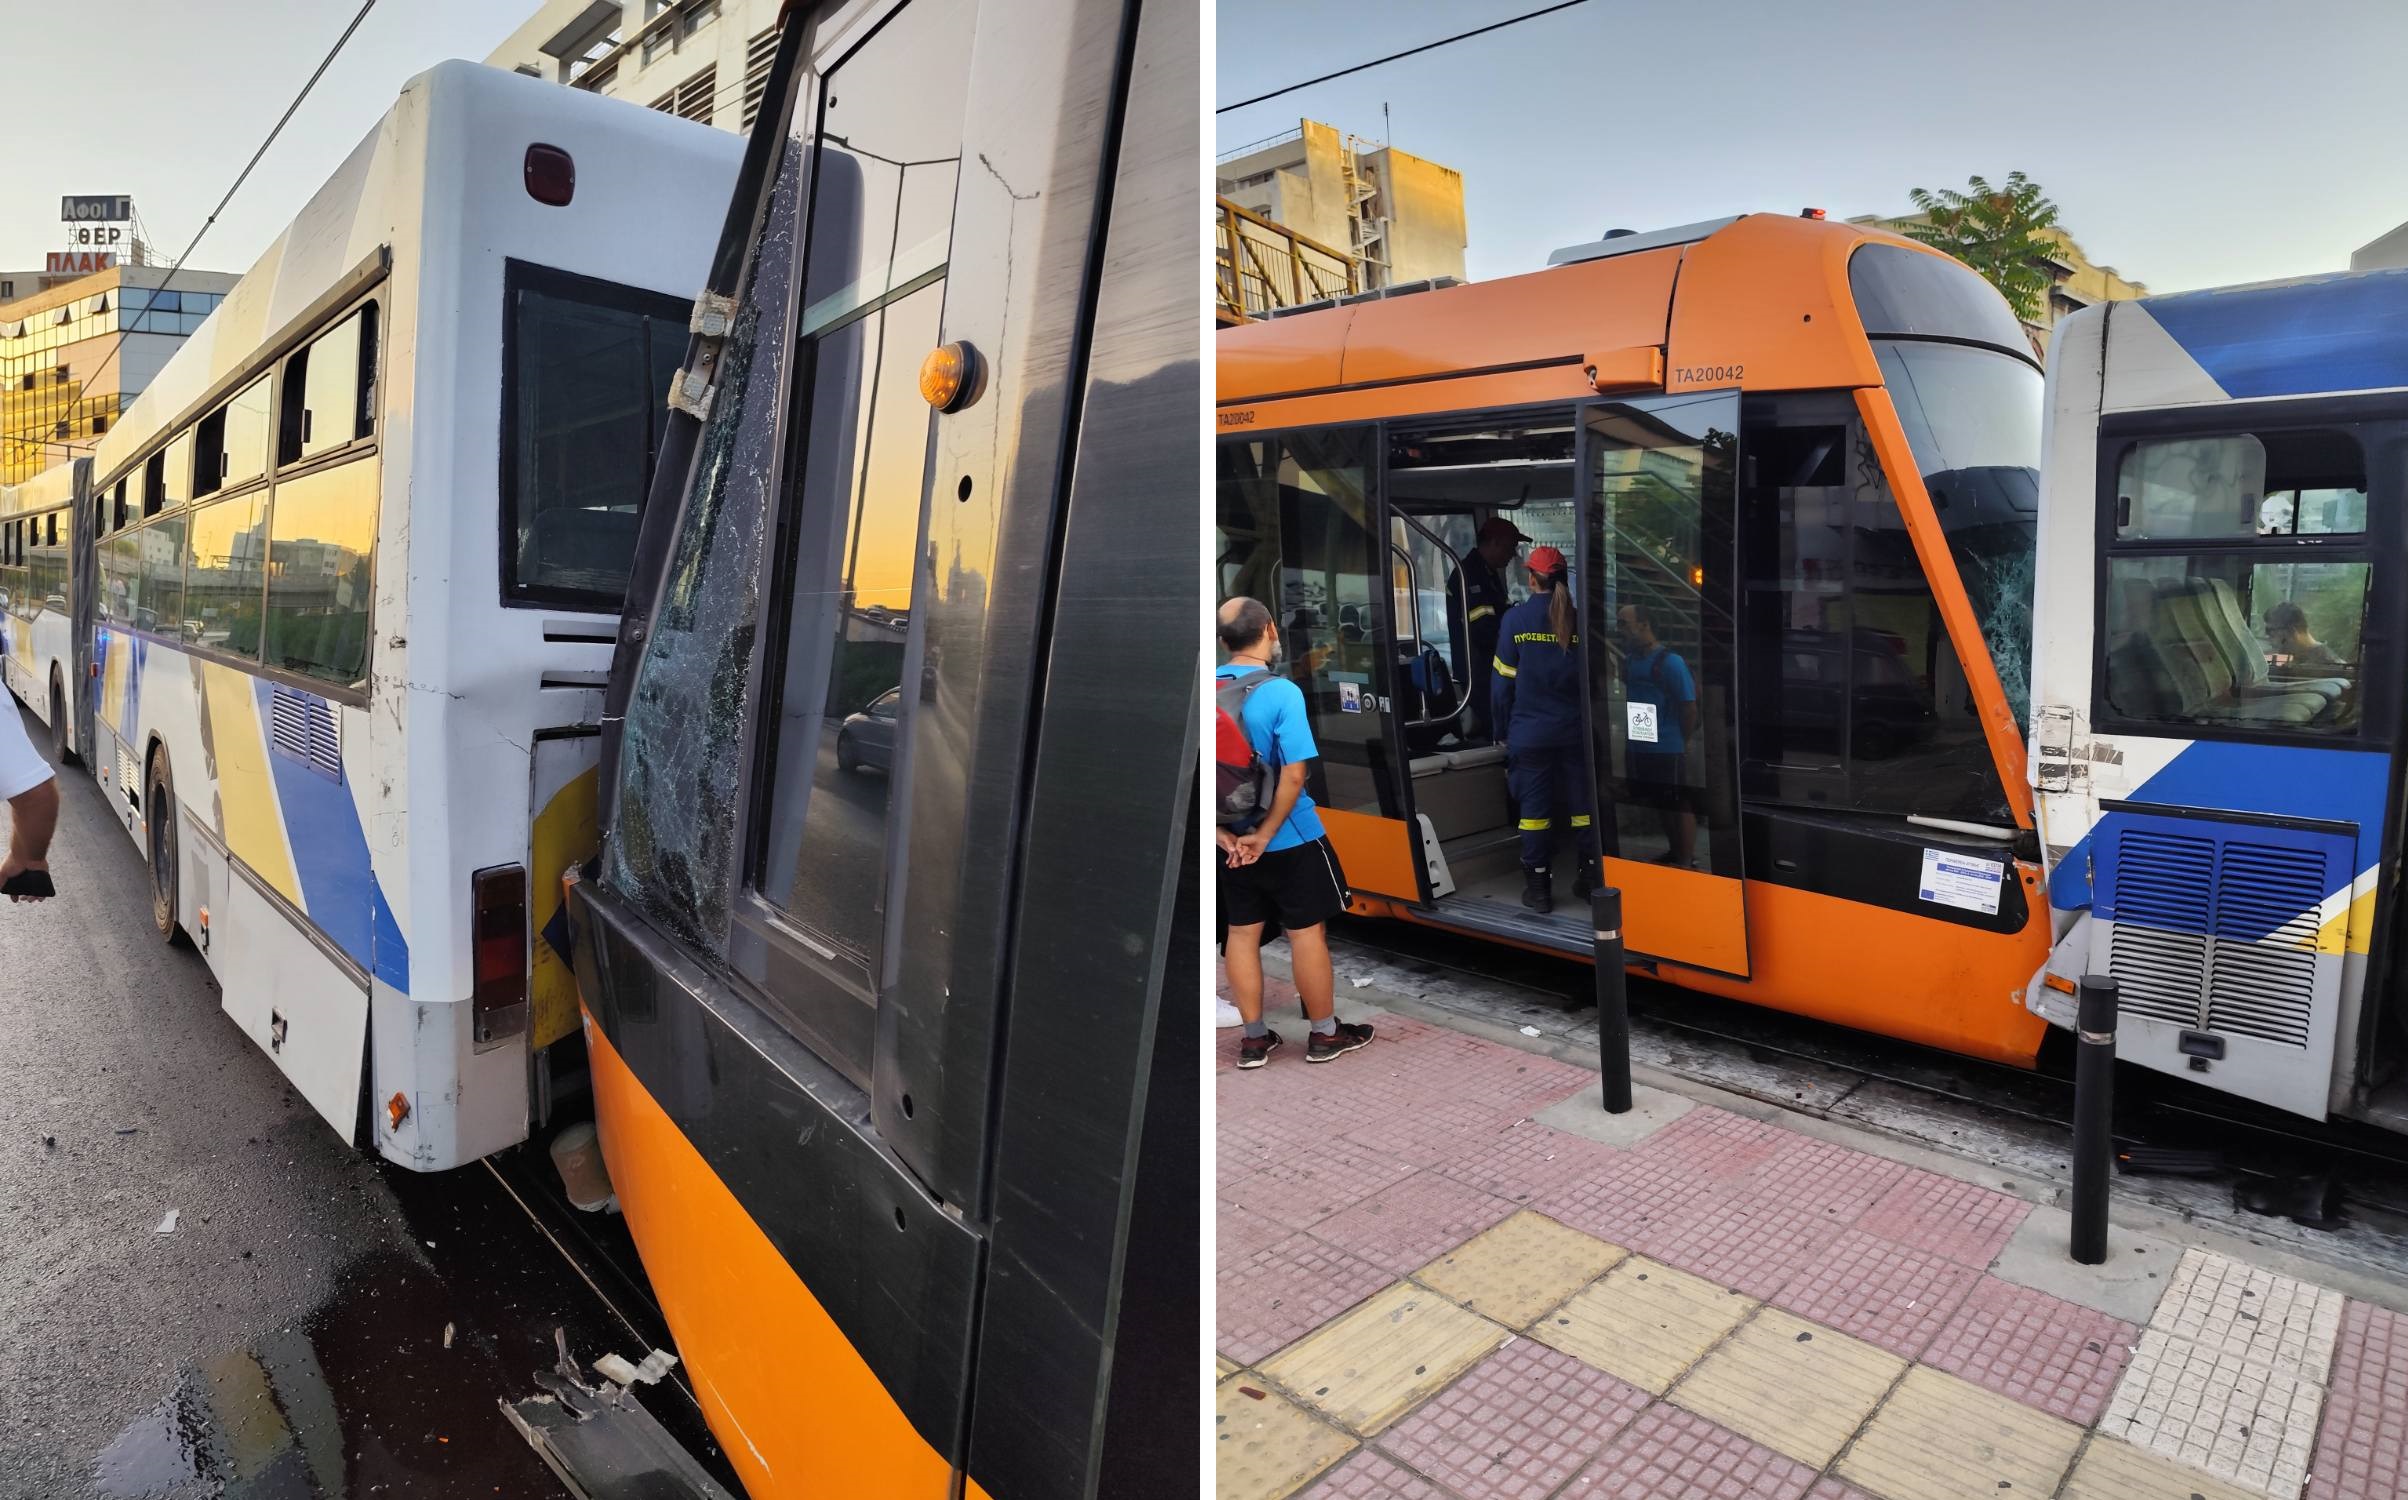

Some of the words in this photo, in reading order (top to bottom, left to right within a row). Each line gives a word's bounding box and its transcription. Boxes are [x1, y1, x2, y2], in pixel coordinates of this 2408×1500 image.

[78, 227, 121, 245] ΘΕΡ
[47, 252, 109, 272] ΠΛΑΚ
[1675, 365, 1744, 383] TA20042
